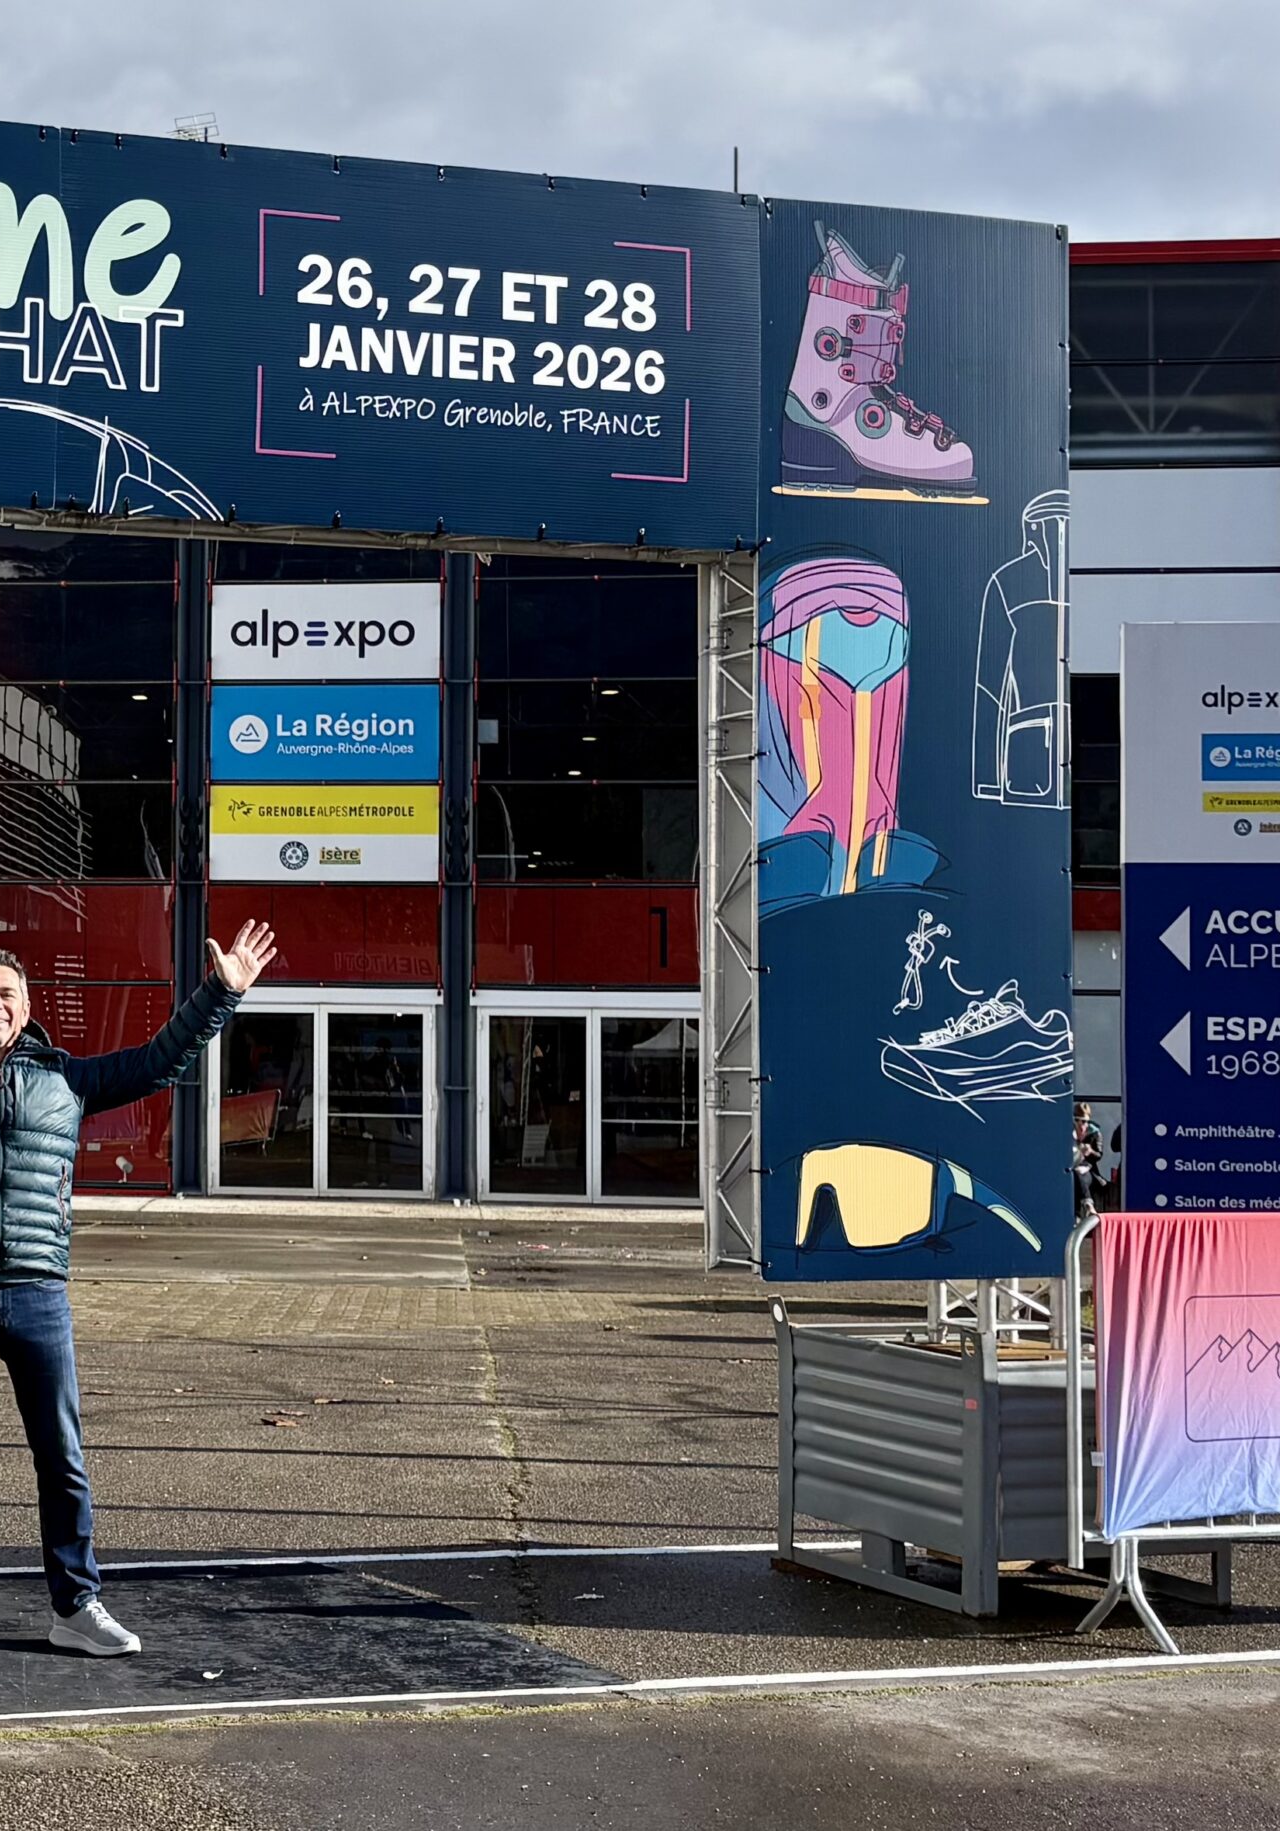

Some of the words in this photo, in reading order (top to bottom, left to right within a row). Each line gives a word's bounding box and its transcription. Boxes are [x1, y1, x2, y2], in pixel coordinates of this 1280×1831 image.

[296, 253, 389, 322] 26,
[408, 263, 481, 317] 27
[502, 271, 569, 325] ET
[584, 279, 657, 333] 28
[298, 322, 516, 384] JANVIER
[532, 341, 666, 395] 2026
[298, 388, 314, 412] à
[321, 391, 436, 420] ALPEXPO
[443, 398, 553, 433] Grenoble,
[562, 408, 662, 438] FRANCE
[276, 714, 308, 737] La
[315, 712, 415, 742] Région
[276, 742, 415, 757] Auvergne-Rhône-Alpes
[1234, 746, 1252, 759] La
[320, 846, 360, 861] isère
[1206, 1050, 1280, 1080] 1968
[1174, 1125, 1276, 1140] Amphithéâtre
[1174, 1159, 1216, 1172] Salon
[1174, 1195, 1216, 1208] Salon
[1219, 1196, 1246, 1209] des
